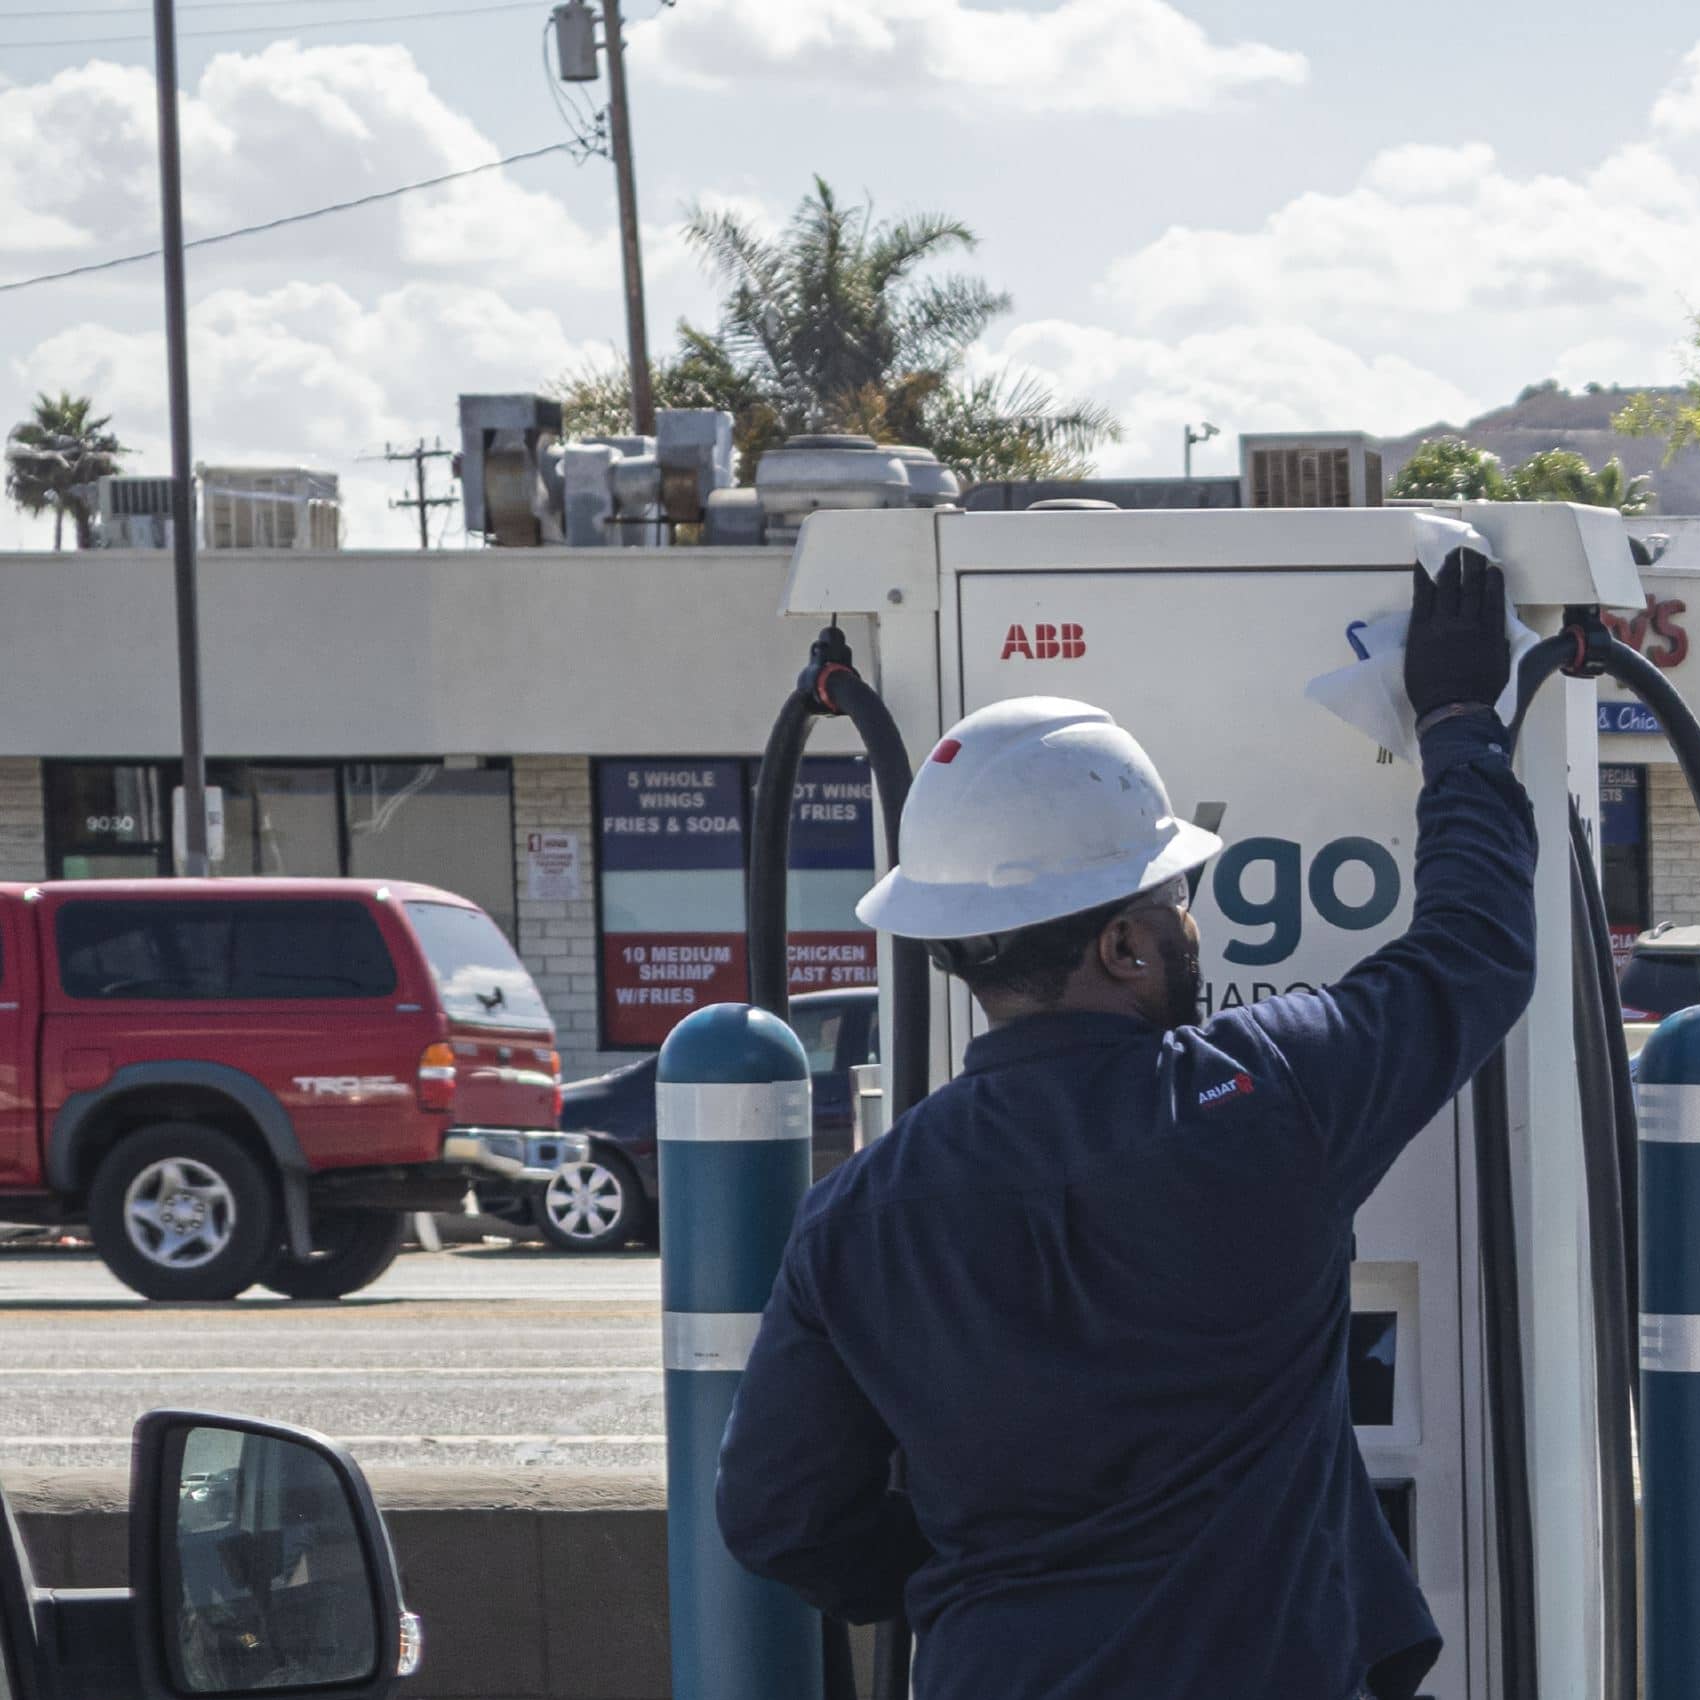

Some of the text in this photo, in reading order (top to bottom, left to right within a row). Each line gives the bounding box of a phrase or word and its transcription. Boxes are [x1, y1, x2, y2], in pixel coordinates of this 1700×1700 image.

[1000, 623, 1087, 660] ABB
[628, 771, 715, 787] 5 WHOLE
[639, 792, 704, 808] WINGS
[800, 803, 857, 820] FRIES
[86, 814, 135, 832] 9030
[603, 816, 741, 833] FRIES & SODA
[622, 946, 731, 962] 10 MEDIUM
[639, 965, 716, 981] SHRIMP
[616, 987, 696, 1005] W/FRIES
[1199, 1079, 1238, 1105] ARIAT
